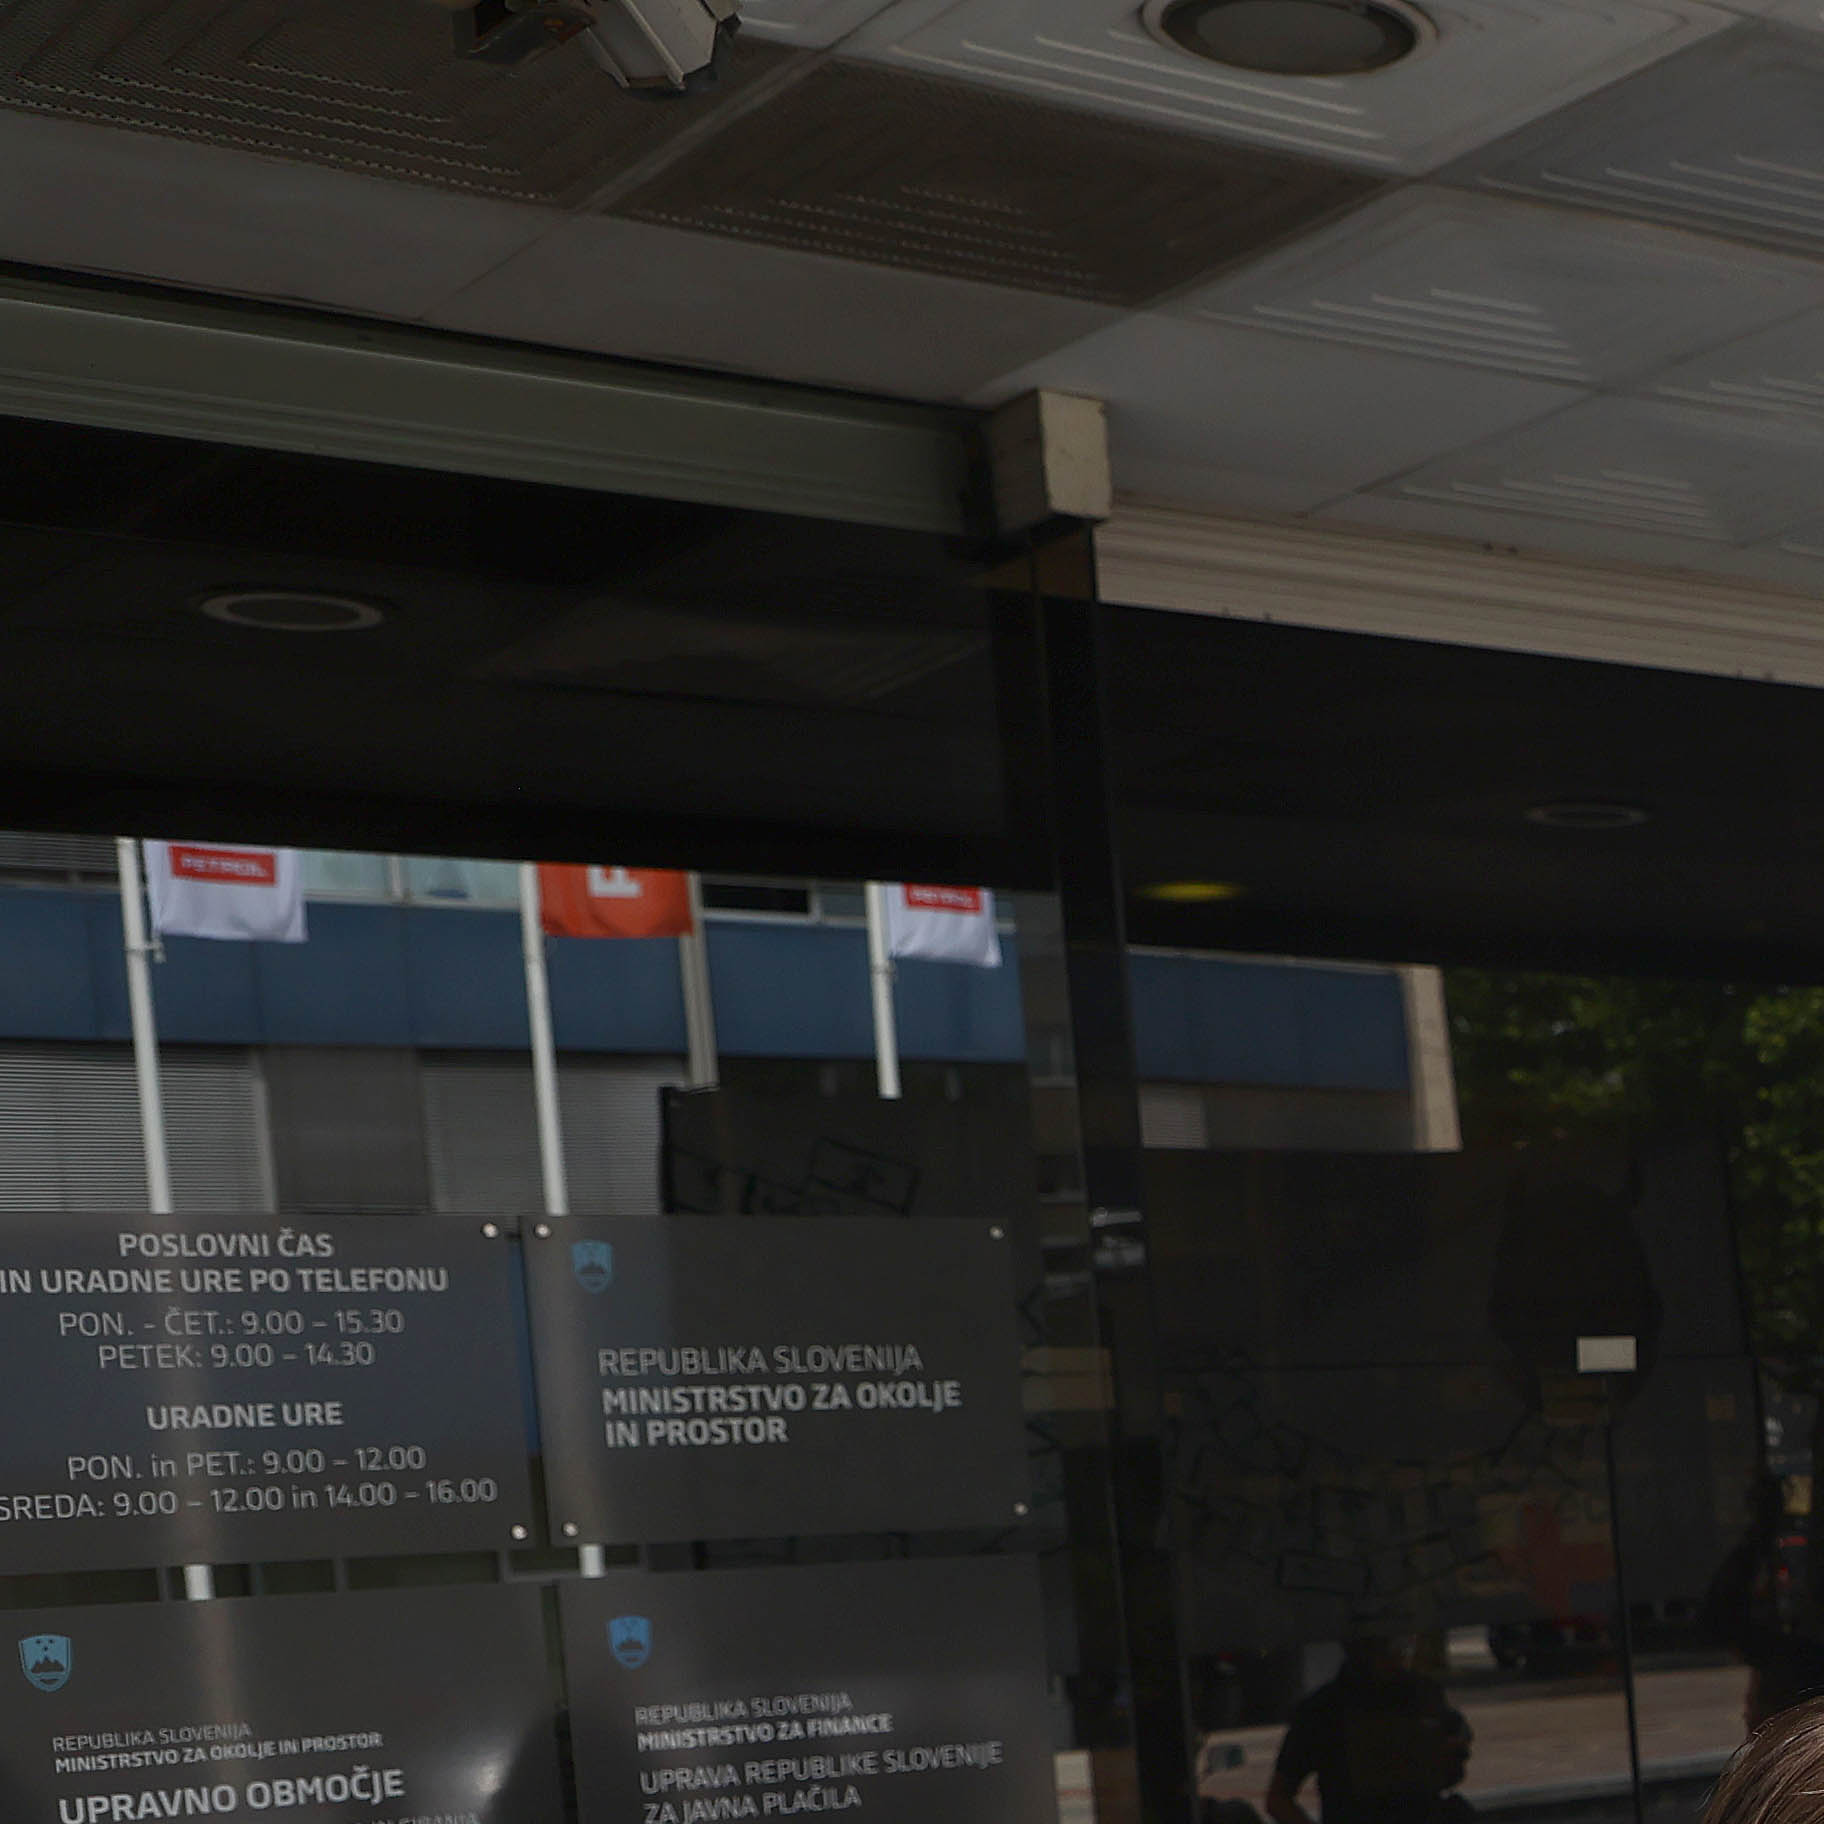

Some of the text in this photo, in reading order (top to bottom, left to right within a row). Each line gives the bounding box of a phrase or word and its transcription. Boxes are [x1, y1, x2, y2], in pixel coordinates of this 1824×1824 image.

[118, 1227, 335, 1258] POSLOVNI ČAS
[41, 1268, 174, 1294] URADNE
[180, 1268, 243, 1293] URE
[250, 1268, 290, 1293] PO
[297, 1266, 449, 1292] TELEFONU
[59, 1311, 135, 1337] PON.
[241, 1310, 304, 1335] 9.00
[335, 1309, 404, 1334] 15.30
[99, 1344, 201, 1369] PETEK:
[210, 1343, 275, 1368] 9.00
[304, 1341, 375, 1367] 14.30
[599, 1343, 924, 1377] REPUBLIKA SLOVENIJA
[601, 1380, 963, 1416] MINISTRSTVO ZA OKOLJE
[146, 1401, 344, 1430] URADNE URE
[605, 1415, 789, 1448] IN PROSTOR
[67, 1455, 143, 1481] PON.
[152, 1452, 176, 1478] in
[262, 1448, 326, 1474] 9.00
[355, 1445, 427, 1471] 12.00
[113, 1490, 178, 1517] 9.00
[210, 1485, 285, 1513] 12.00
[291, 1484, 319, 1510] in
[324, 1481, 398, 1508] 14.00
[426, 1477, 499, 1504] 16.00
[635, 1691, 855, 1726] REPUBLIKA SLOVENIJA
[53, 1722, 253, 1753] REPUBLIKA SLOVENIJA
[637, 1712, 894, 1752] MINISTRSTVO ZA FINANCE
[55, 1731, 384, 1775] MINISTRSTVO ZA OKOLJE IN PROSTOR
[640, 1740, 1004, 1796] UPRAVA REPUBLIKE SLOVENIJE
[246, 1763, 406, 1810] OBMOČJE
[762, 1784, 863, 1817] PLAČILA
